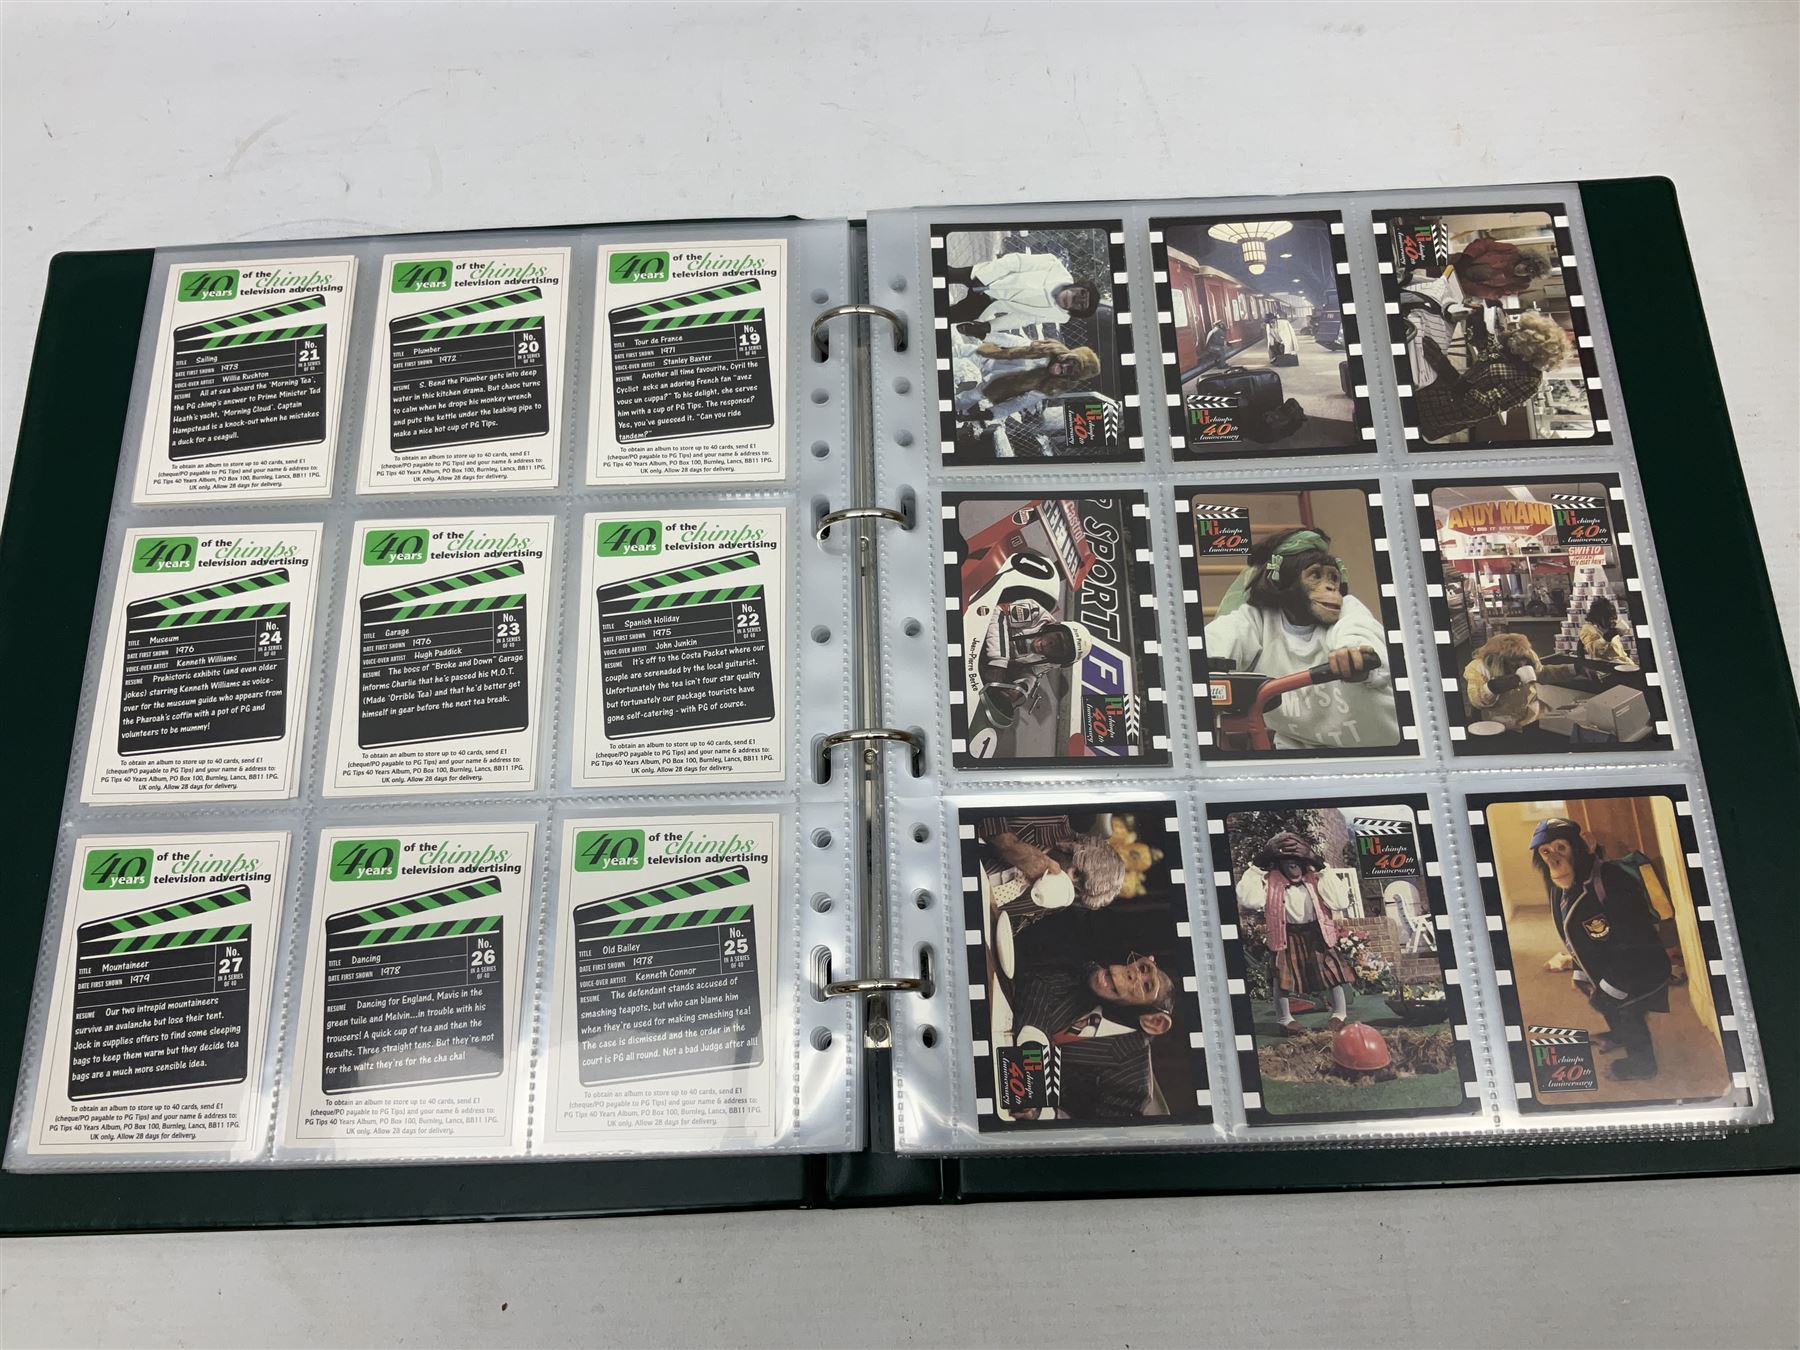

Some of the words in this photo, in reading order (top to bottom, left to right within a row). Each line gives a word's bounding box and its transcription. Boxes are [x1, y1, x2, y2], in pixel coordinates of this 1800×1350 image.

[686, 253, 702, 261] the
[688, 252, 766, 270] chimps
[470, 261, 548, 279] chimps
[615, 255, 664, 279] 40
[672, 270, 718, 278] television
[722, 268, 777, 277] advertising
[256, 269, 333, 287] chimps
[398, 264, 447, 288] 40
[454, 278, 501, 287] television
[504, 277, 559, 285] advertising
[633, 271, 664, 282] years
[184, 273, 233, 297] 40
[240, 287, 286, 295] television
[289, 285, 343, 293] advertising
[416, 280, 447, 291] years
[201, 289, 232, 299] years
[744, 325, 756, 333] No.
[523, 333, 536, 341] No.
[634, 338, 649, 346] Tour
[661, 335, 683, 343] France
[739, 333, 760, 345] 19
[305, 341, 317, 349] No.
[414, 346, 441, 355] Plumber
[518, 342, 539, 354] 20
[196, 355, 217, 364] Sailing
[299, 349, 320, 361] 21
[440, 355, 457, 363] 1972
[663, 358, 688, 367] Stanley
[690, 354, 712, 363] Baxter
[222, 374, 240, 382] Willie
[242, 371, 269, 380] Rushton
[1191, 410, 1210, 424] PG
[1202, 423, 1238, 436] 40th
[1449, 502, 1498, 528] ANDY
[1500, 502, 1552, 525] MANN
[1556, 510, 1577, 526] PG
[666, 523, 677, 531] of
[681, 522, 766, 542] chimps
[1200, 520, 1220, 536] PG
[1571, 525, 1607, 536] 40th
[447, 530, 531, 551] chimps
[603, 524, 656, 551] 40
[1212, 535, 1248, 547] 40th
[201, 539, 213, 547] of
[214, 538, 299, 558] chimps
[369, 533, 423, 560] 40
[623, 544, 656, 554] years
[665, 541, 715, 550] television
[719, 540, 777, 550] advertising
[139, 540, 192, 567] 40
[389, 552, 422, 563] years
[431, 550, 480, 559] television
[484, 549, 543, 558] advertising
[156, 559, 190, 571] years
[198, 558, 246, 567] television
[250, 558, 309, 567] advertising
[1081, 517, 1120, 642] SPORT
[742, 603, 755, 613] No.
[503, 613, 516, 622] No.
[624, 618, 652, 628] Spanish
[654, 615, 680, 625] Holiday
[737, 613, 760, 627] 22
[266, 621, 279, 630] No.
[497, 623, 520, 636] 23
[260, 631, 282, 645] 24
[385, 627, 409, 637] Garage
[150, 635, 179, 644] Museum
[656, 641, 672, 650] John
[674, 638, 697, 648] Junkin
[176, 645, 194, 654] 1976
[415, 650, 433, 660] Hugh
[435, 647, 462, 656] Paddick
[177, 658, 205, 667] Kenneth
[208, 654, 237, 664] Williams
[648, 833, 661, 842] of
[664, 832, 682, 841] the
[404, 843, 416, 852] of
[419, 842, 437, 851] the
[580, 833, 639, 865] 40
[665, 831, 757, 855] chimps
[1360, 837, 1381, 856] PG
[157, 852, 169, 861] of
[172, 852, 190, 860] the
[336, 843, 393, 874] 40
[419, 840, 511, 865] chimps
[648, 854, 700, 864] television
[705, 853, 768, 864] advertising
[90, 852, 147, 883] 40
[171, 850, 261, 874] chimps
[602, 856, 638, 868] years
[1375, 854, 1413, 869] 40th
[357, 865, 392, 879] years
[401, 864, 454, 874] television
[458, 863, 521, 874] advertising
[110, 875, 145, 887] years
[154, 873, 205, 883] television
[209, 873, 271, 883] advertising
[730, 927, 744, 938] No.
[478, 938, 492, 948] No.
[603, 944, 615, 954] Old
[617, 942, 640, 954] Bailey
[724, 939, 748, 955] 25
[226, 946, 240, 957] No.
[351, 953, 380, 965] Dancing
[471, 950, 495, 966] 26
[633, 956, 653, 965] 1978
[102, 960, 149, 972] Mountaineer
[219, 957, 243, 973] 27
[380, 966, 401, 976] 1978
[130, 974, 150, 984] 1979
[636, 969, 667, 981] Kenneth
[669, 966, 696, 977] Connor
[106, 1007, 119, 1017] Our
[122, 1006, 135, 1015] two
[137, 1002, 166, 1014] intrepid
[168, 996, 218, 1010] mountaineers
[1535, 1046, 1558, 1066] PG
[1552, 1066, 1592, 1081] 40th
